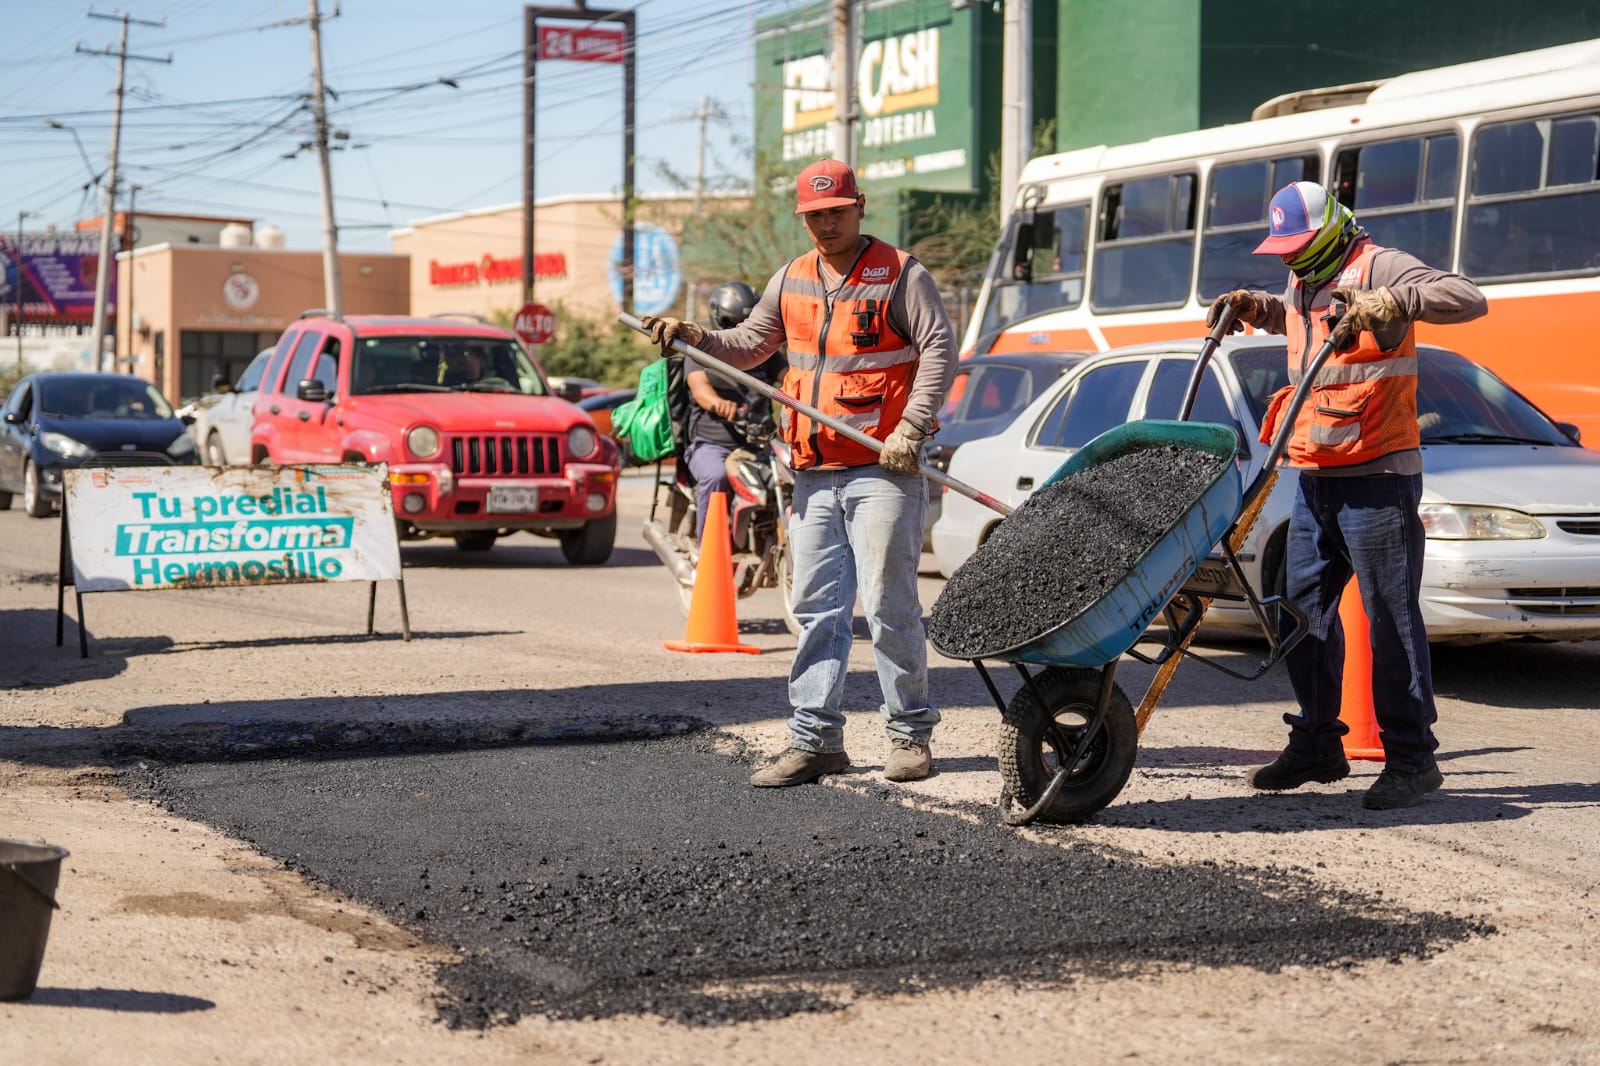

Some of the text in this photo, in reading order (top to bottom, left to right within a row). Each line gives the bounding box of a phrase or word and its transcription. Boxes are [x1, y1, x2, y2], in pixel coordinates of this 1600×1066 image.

[858, 27, 938, 118] CASH
[861, 266, 890, 277] DGDI
[515, 314, 553, 334] ALTO
[132, 486, 327, 523] Tu predial
[124, 520, 347, 555] Transforma
[132, 551, 343, 586] Hermosillo
